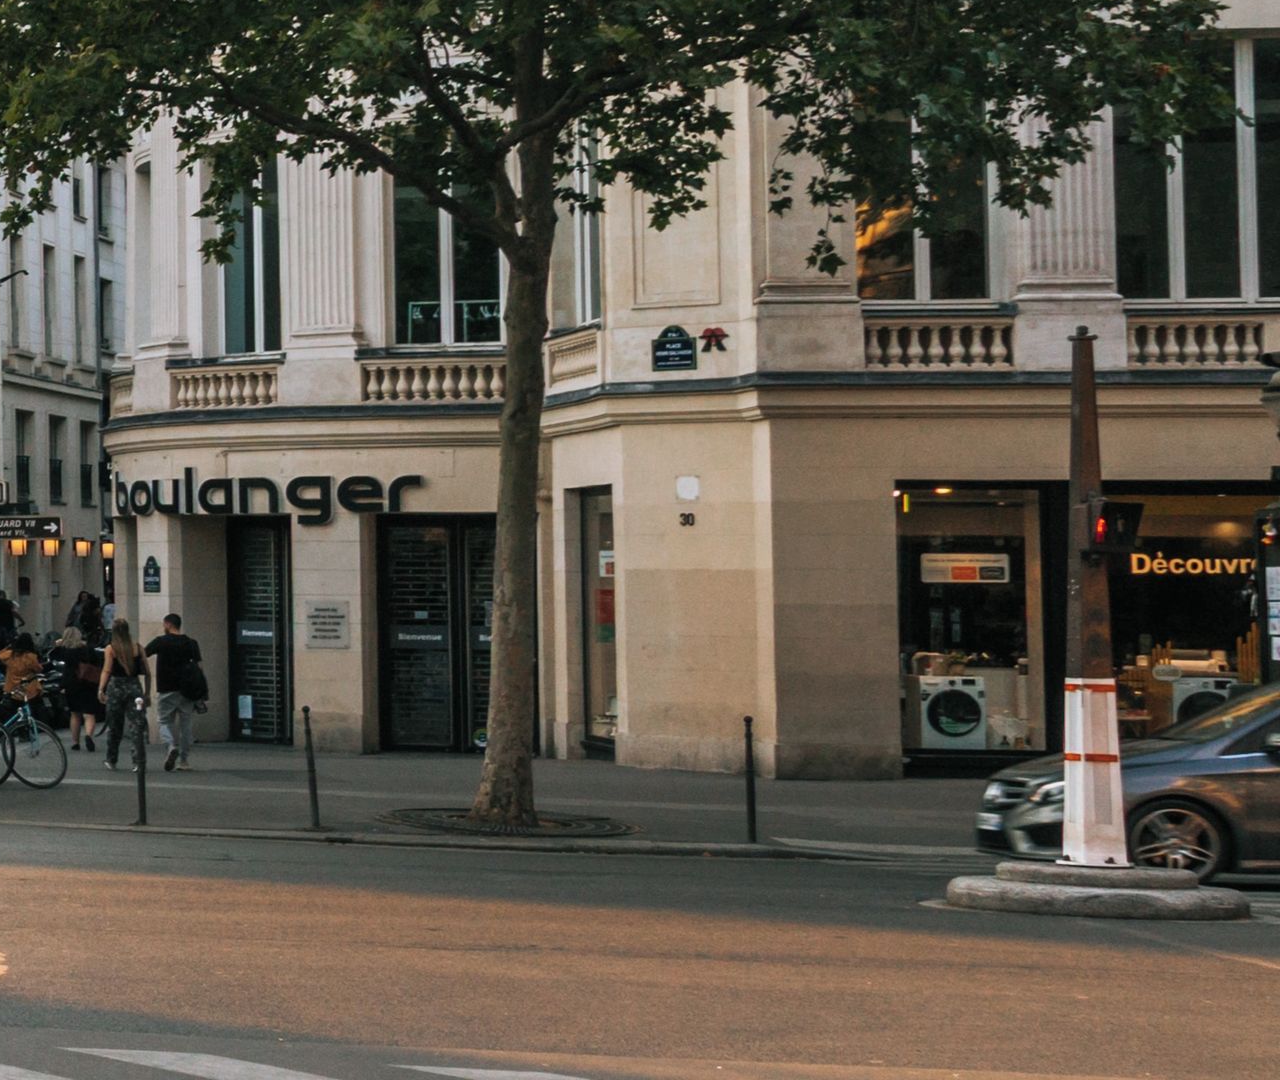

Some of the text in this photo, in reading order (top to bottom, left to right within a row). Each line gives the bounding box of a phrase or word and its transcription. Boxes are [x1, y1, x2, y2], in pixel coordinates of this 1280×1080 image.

[115, 467, 424, 527] boulanger
[679, 512, 695, 527] 30
[398, 633, 442, 642] Bienvenue
